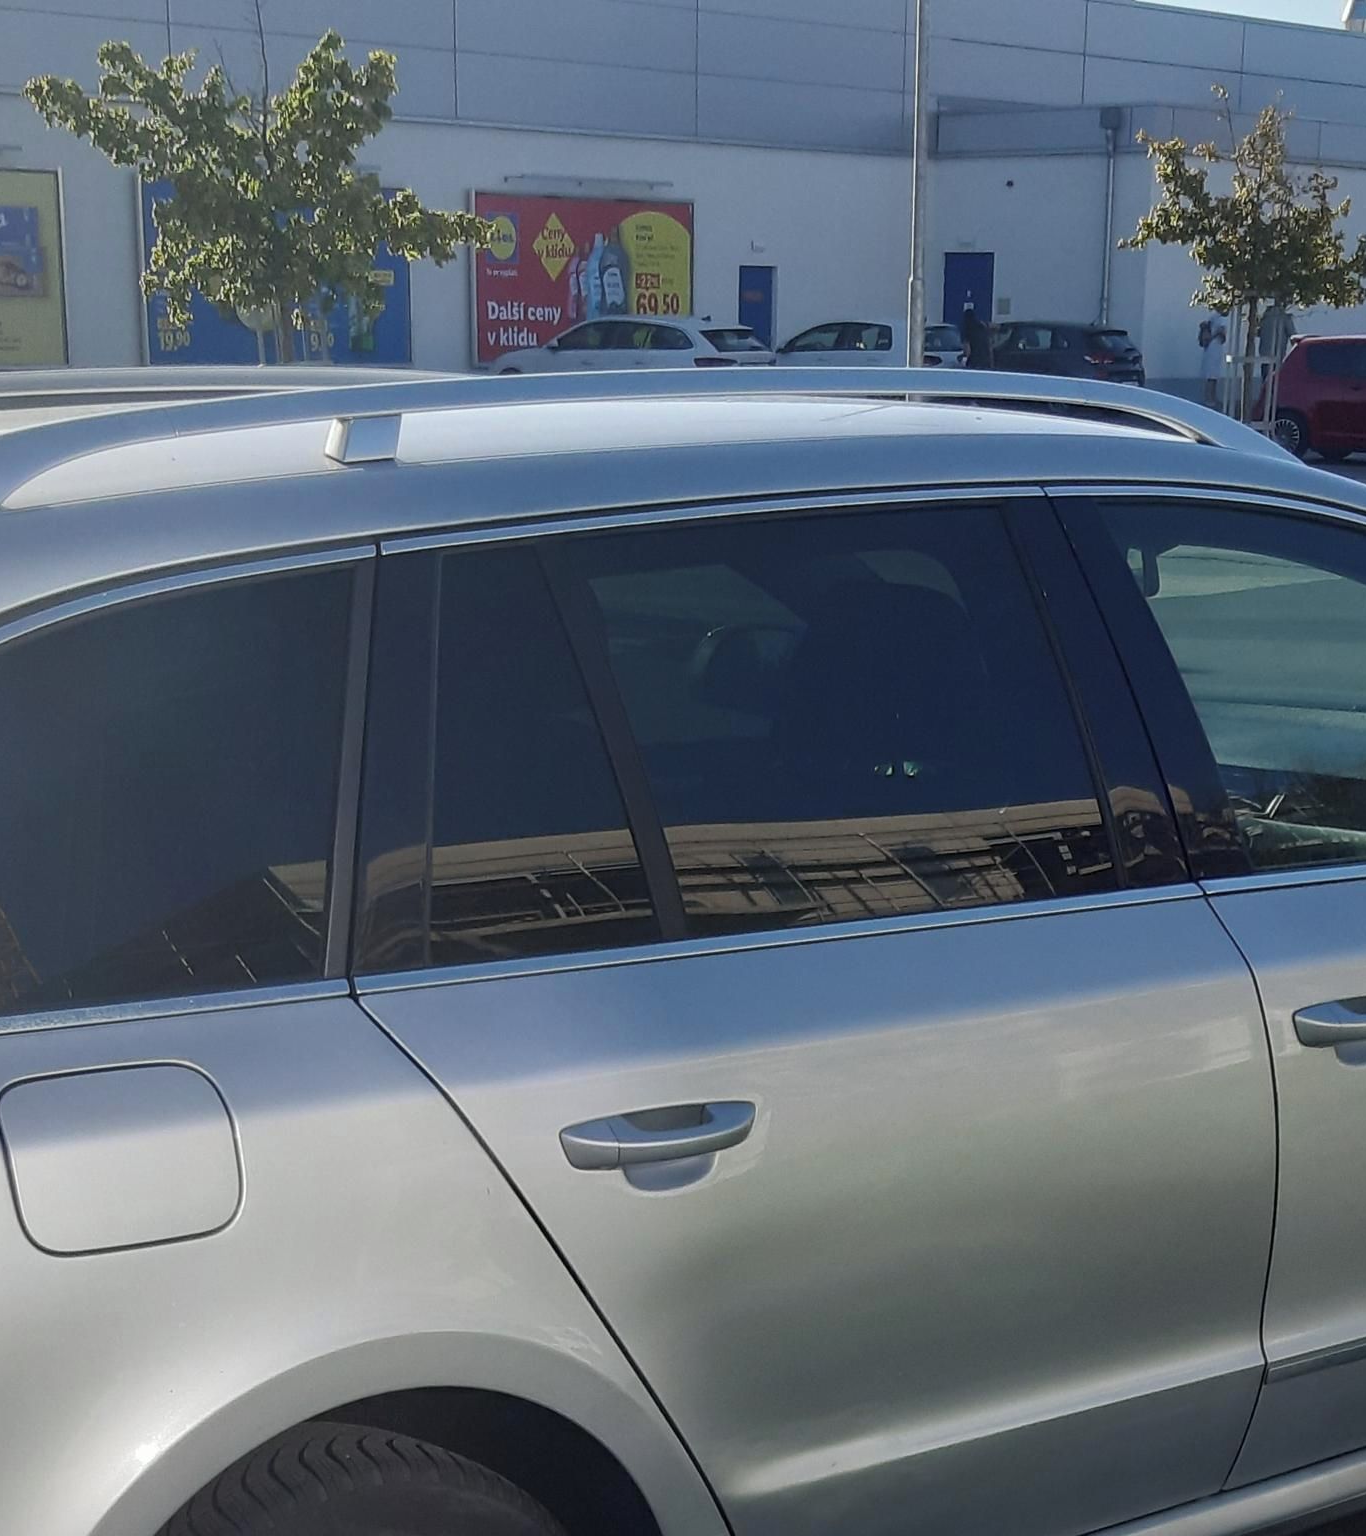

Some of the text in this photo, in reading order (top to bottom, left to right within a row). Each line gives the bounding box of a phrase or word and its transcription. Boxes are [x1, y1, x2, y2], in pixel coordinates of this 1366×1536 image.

[541, 227, 566, 242] Ceny
[545, 244, 571, 258] klidu
[486, 300, 561, 325] Další ceny
[486, 326, 537, 346] v klidu
